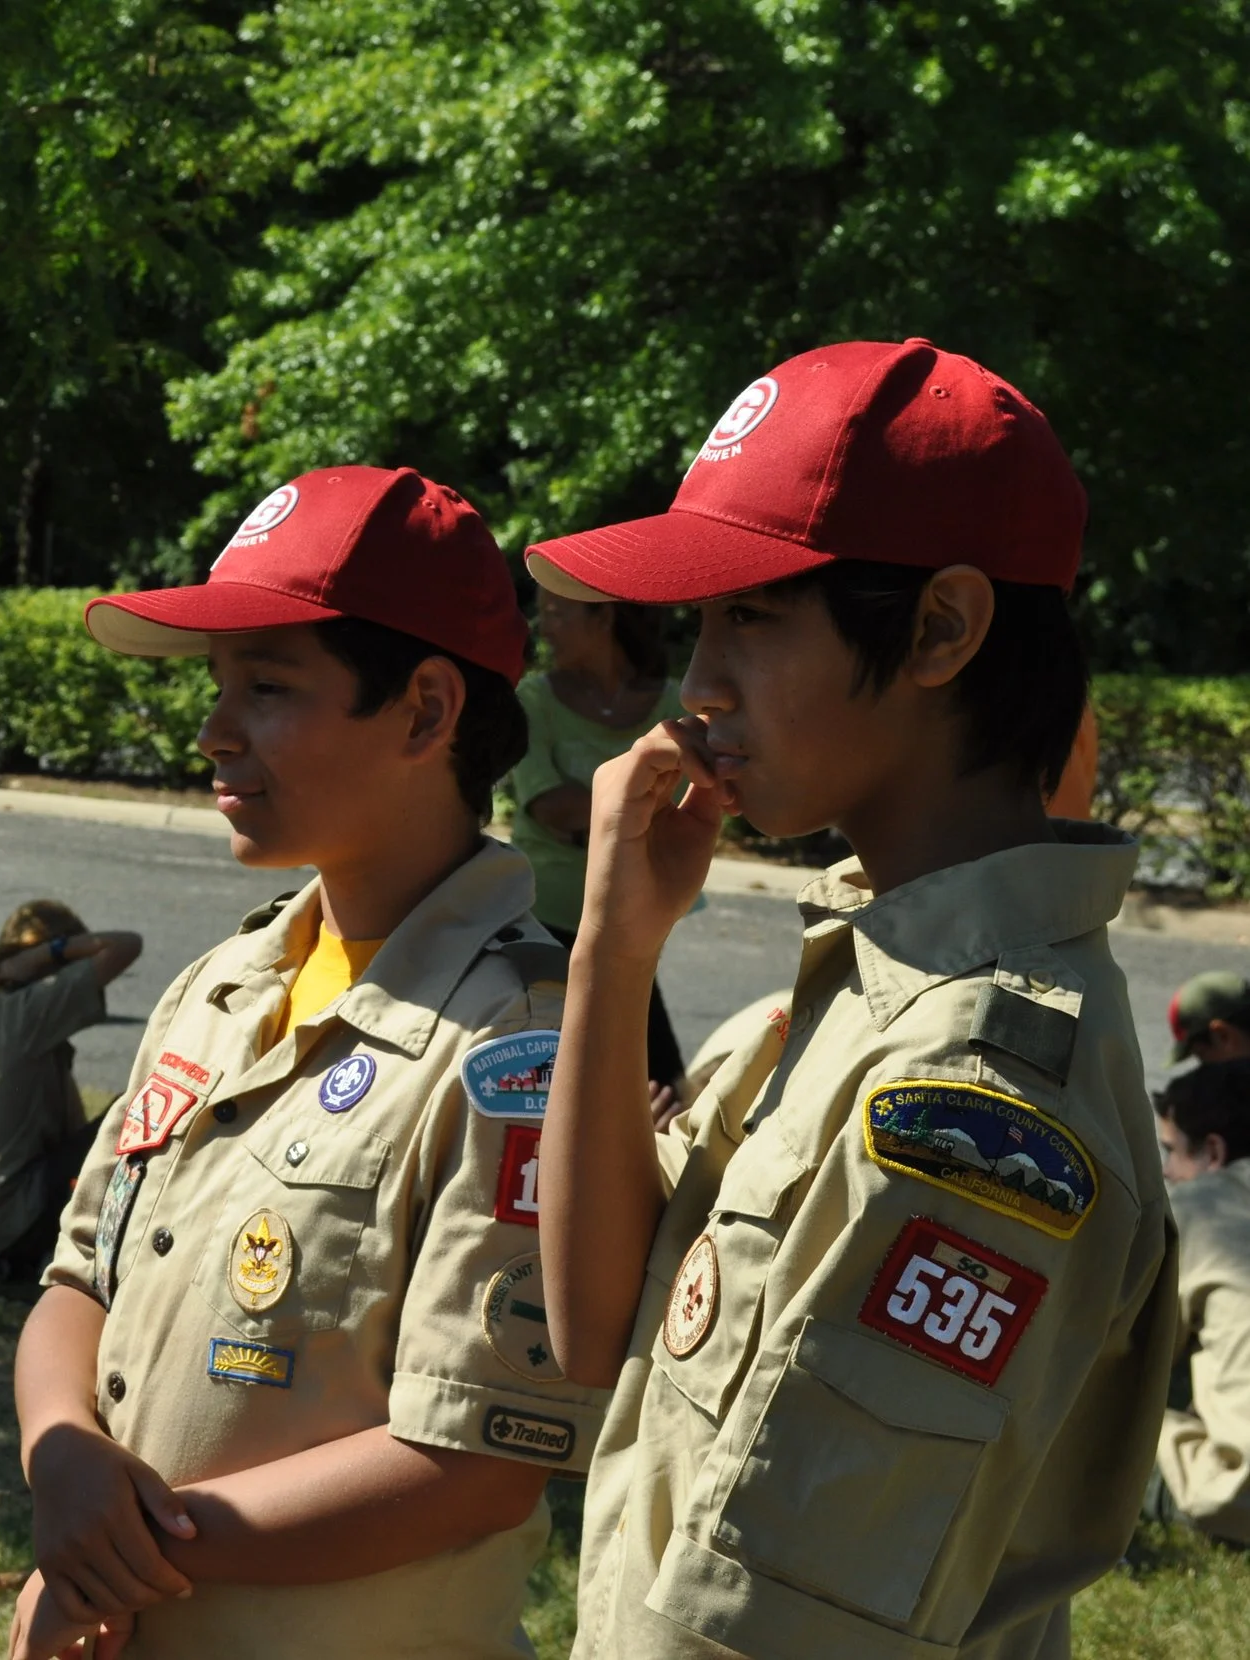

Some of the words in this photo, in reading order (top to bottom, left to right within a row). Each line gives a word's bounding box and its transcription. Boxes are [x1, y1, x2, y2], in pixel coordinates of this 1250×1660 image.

[472, 1044, 525, 1074] NATIONAL
[526, 1041, 558, 1055] CAPIT
[895, 1092, 943, 1106] SANTA
[945, 1093, 993, 1113] CLARA
[996, 1104, 1050, 1139] COUNTY
[1049, 1134, 1086, 1184] COUNCIL
[940, 1167, 1022, 1209] CALIFORNIA
[957, 1256, 990, 1280] 50
[489, 1262, 534, 1323] ASSISTANT
[886, 1254, 1017, 1360] 535
[512, 1421, 569, 1451] Trained
